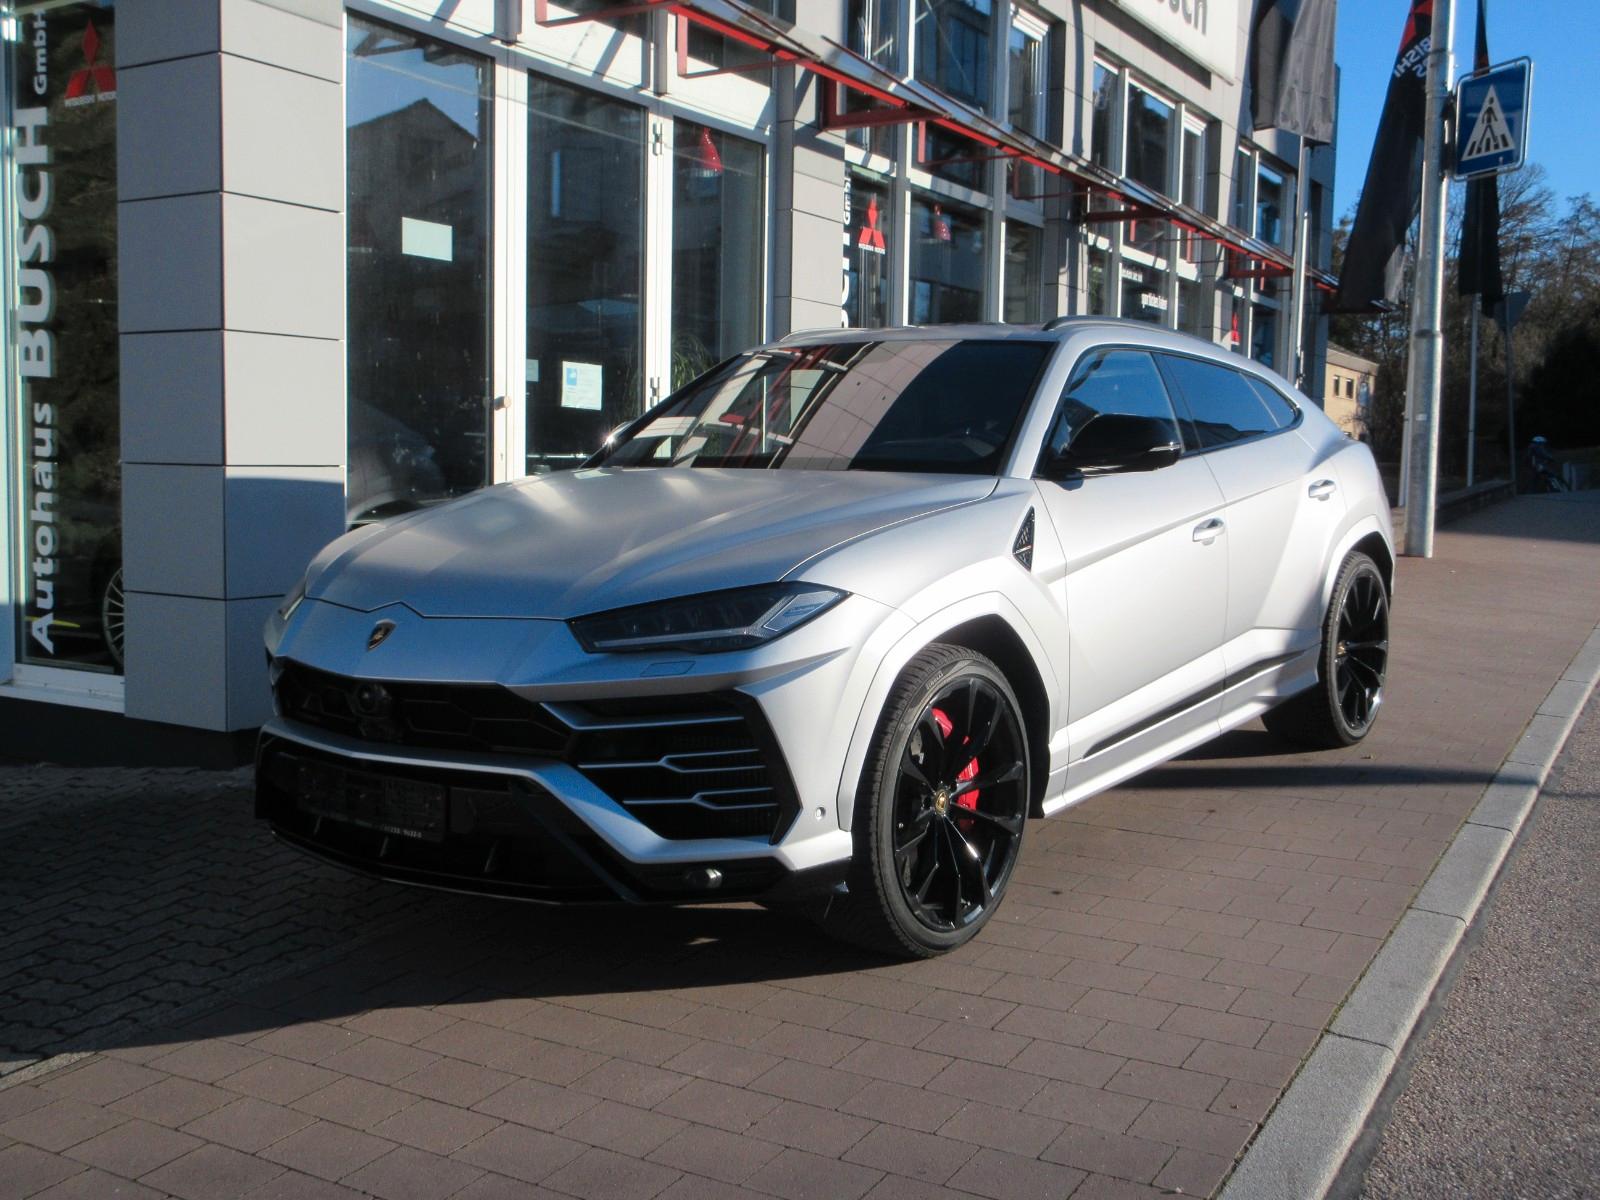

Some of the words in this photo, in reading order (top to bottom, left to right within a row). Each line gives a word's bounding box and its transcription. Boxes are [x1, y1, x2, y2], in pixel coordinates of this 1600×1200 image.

[33, 8, 47, 95] GmbH
[14, 106, 51, 377] BUSCH
[31, 402, 54, 654] Autohaus
